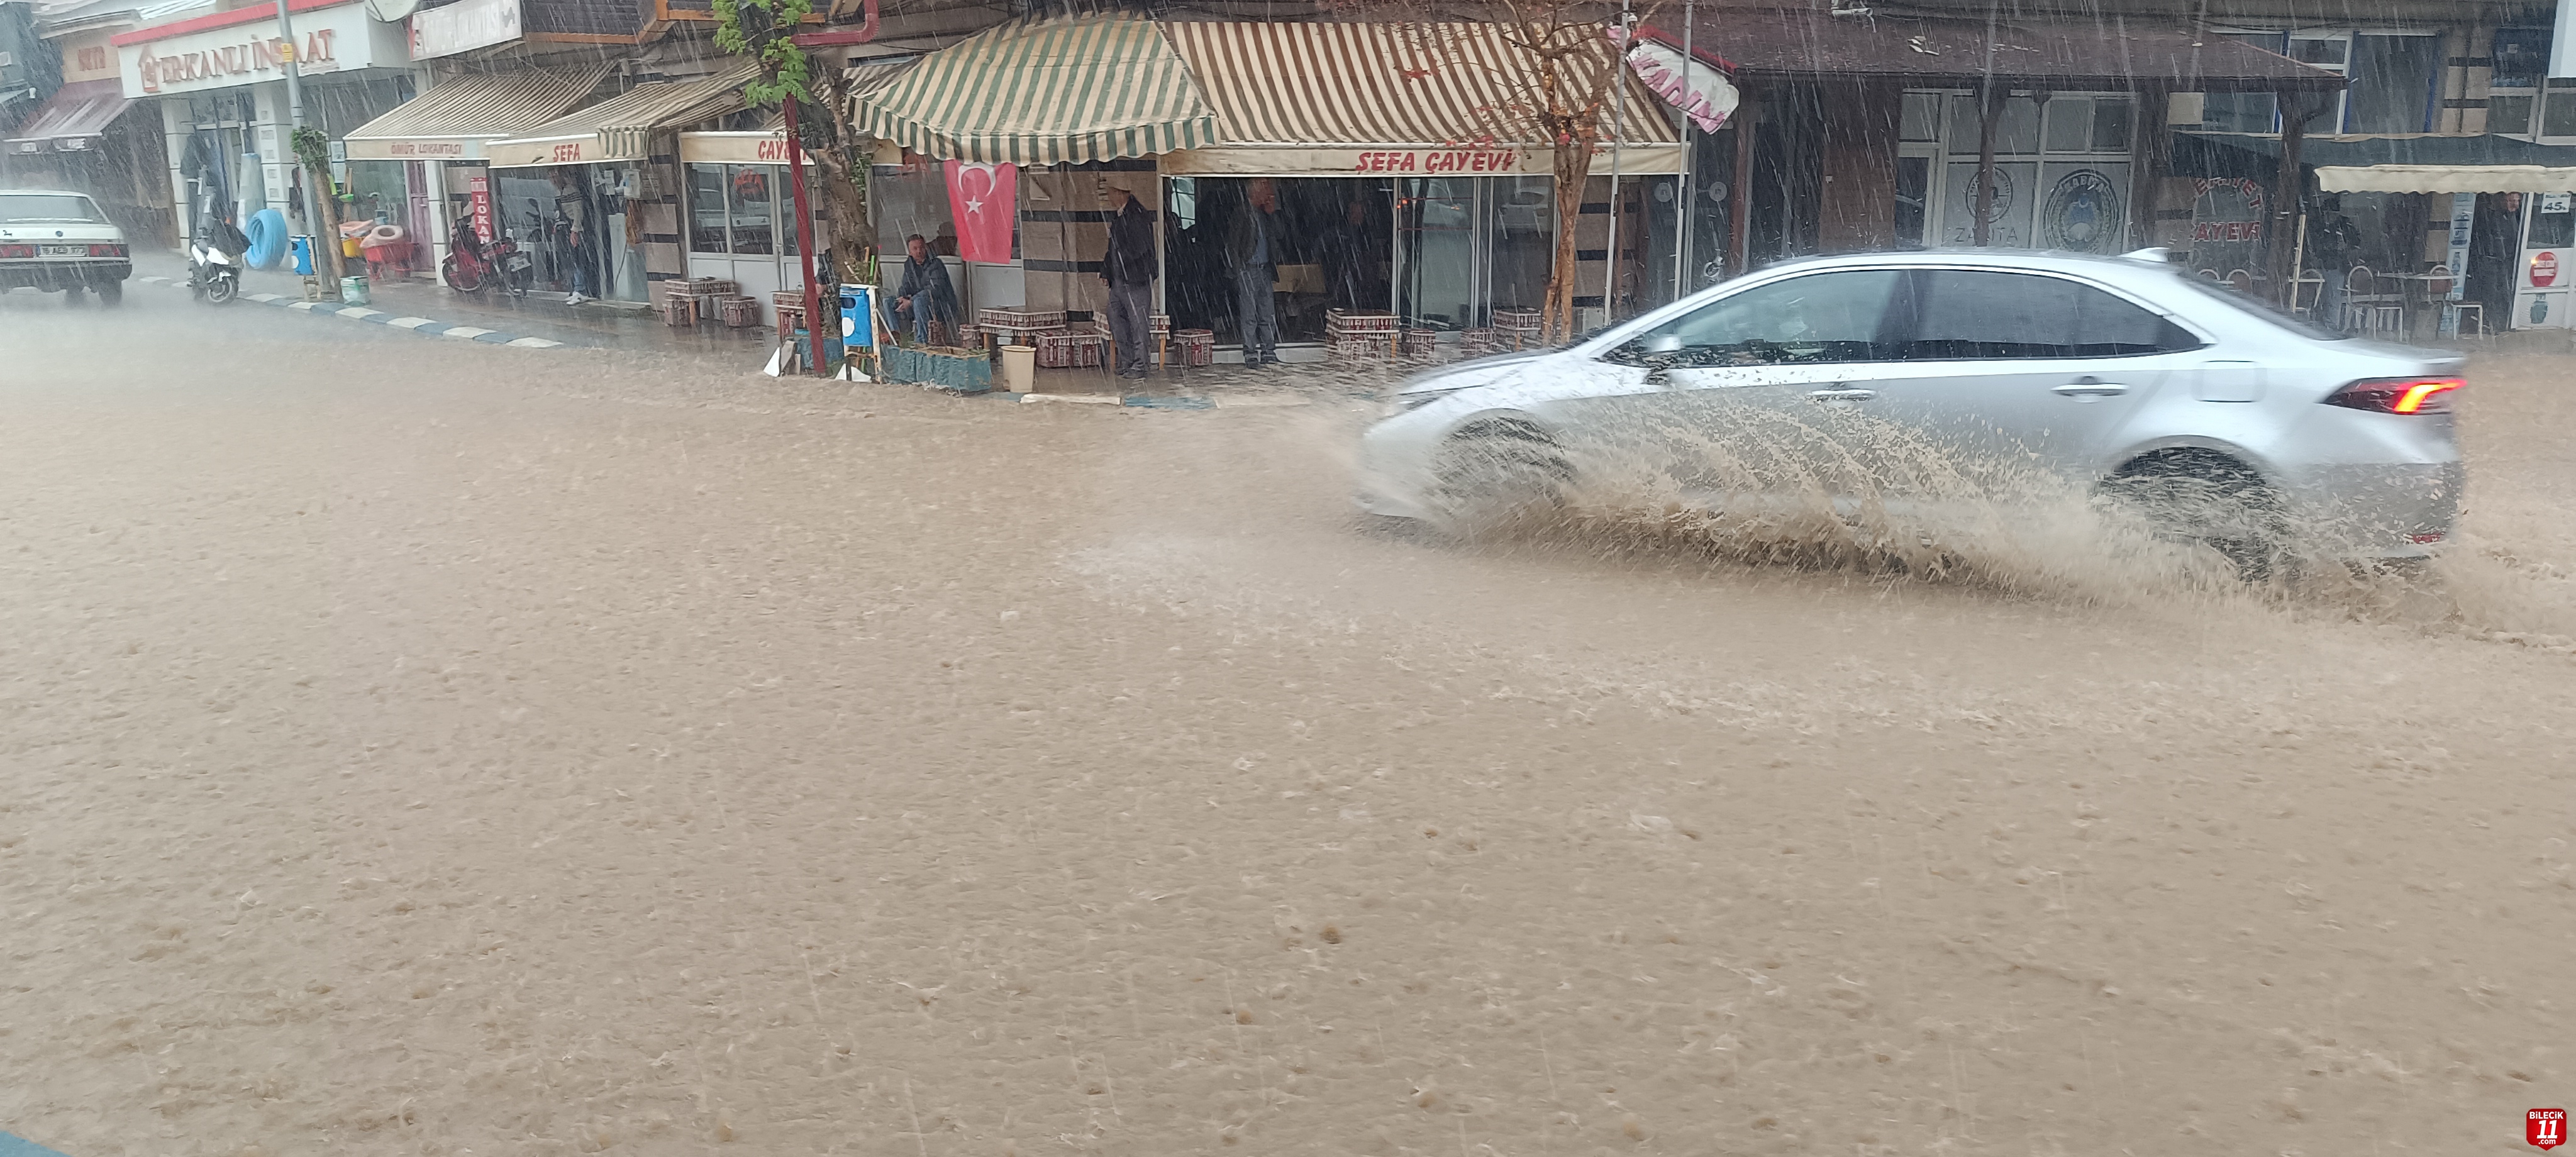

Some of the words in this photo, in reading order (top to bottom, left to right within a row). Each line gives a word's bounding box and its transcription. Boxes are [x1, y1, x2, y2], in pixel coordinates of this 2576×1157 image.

[553, 143, 580, 162] SEFA
[1355, 152, 1416, 172] SEFA
[1424, 149, 1513, 174] ÇAYEVİ
[1954, 227, 2018, 243] ZITA
